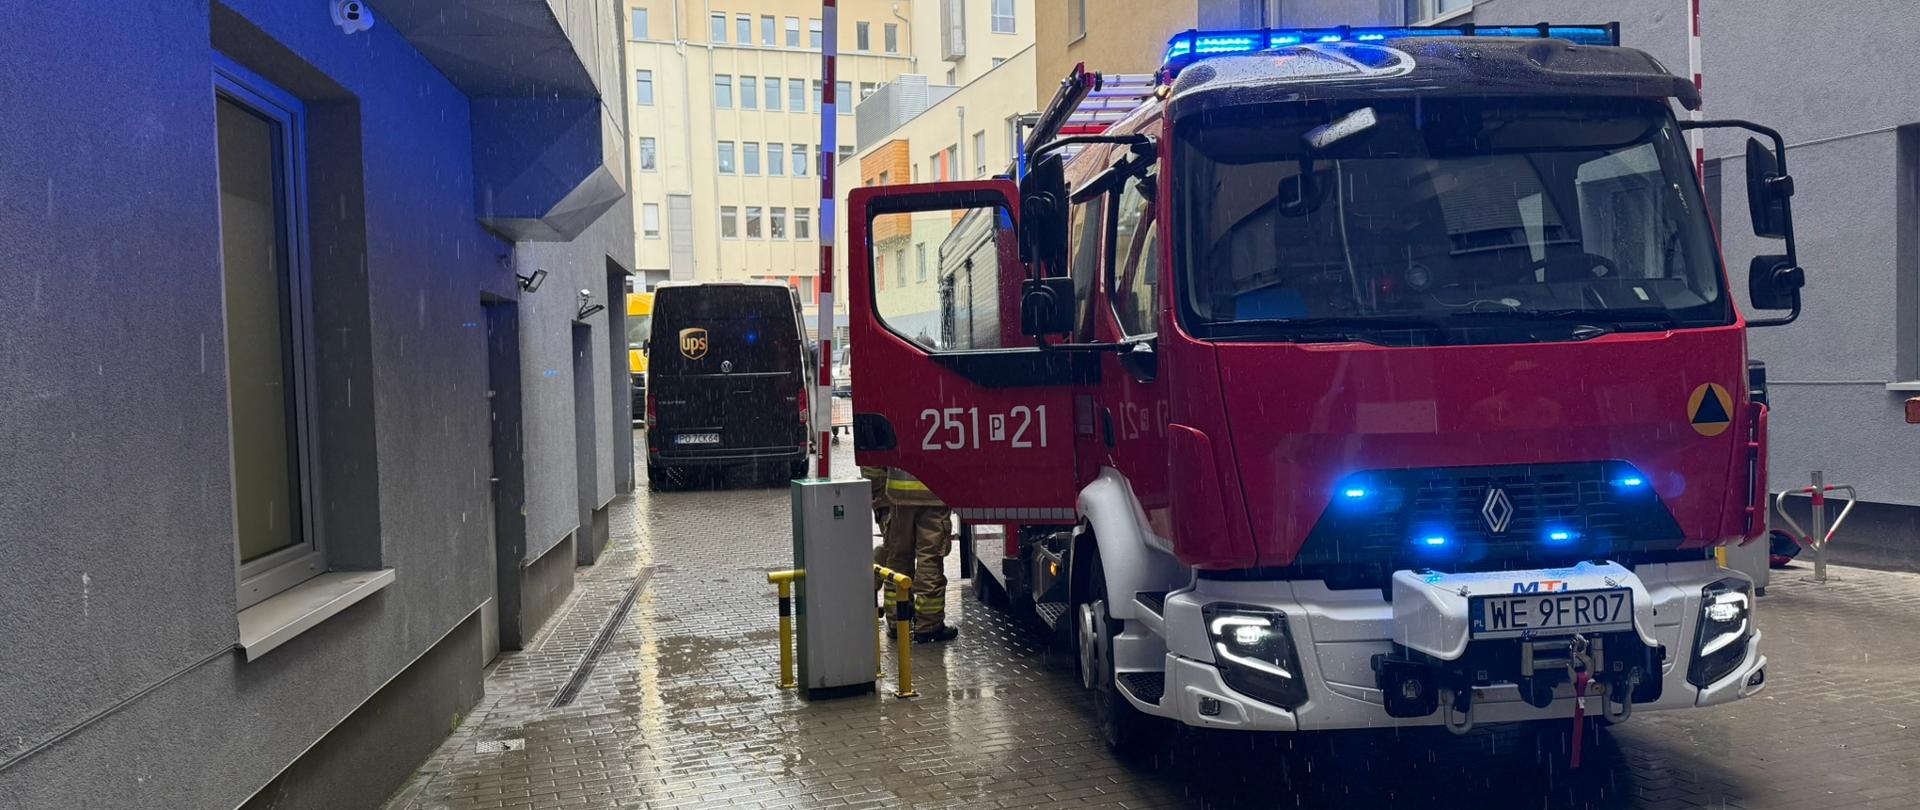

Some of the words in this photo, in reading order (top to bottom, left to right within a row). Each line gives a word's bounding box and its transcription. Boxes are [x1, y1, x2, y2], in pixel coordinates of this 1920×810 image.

[682, 337, 706, 355] ups
[920, 407, 979, 450] 251
[991, 415, 1003, 439] P
[1010, 404, 1047, 448] 21
[1473, 619, 1484, 628] PL
[1490, 599, 1528, 629] WE
[1539, 593, 1625, 626] 9FR07
